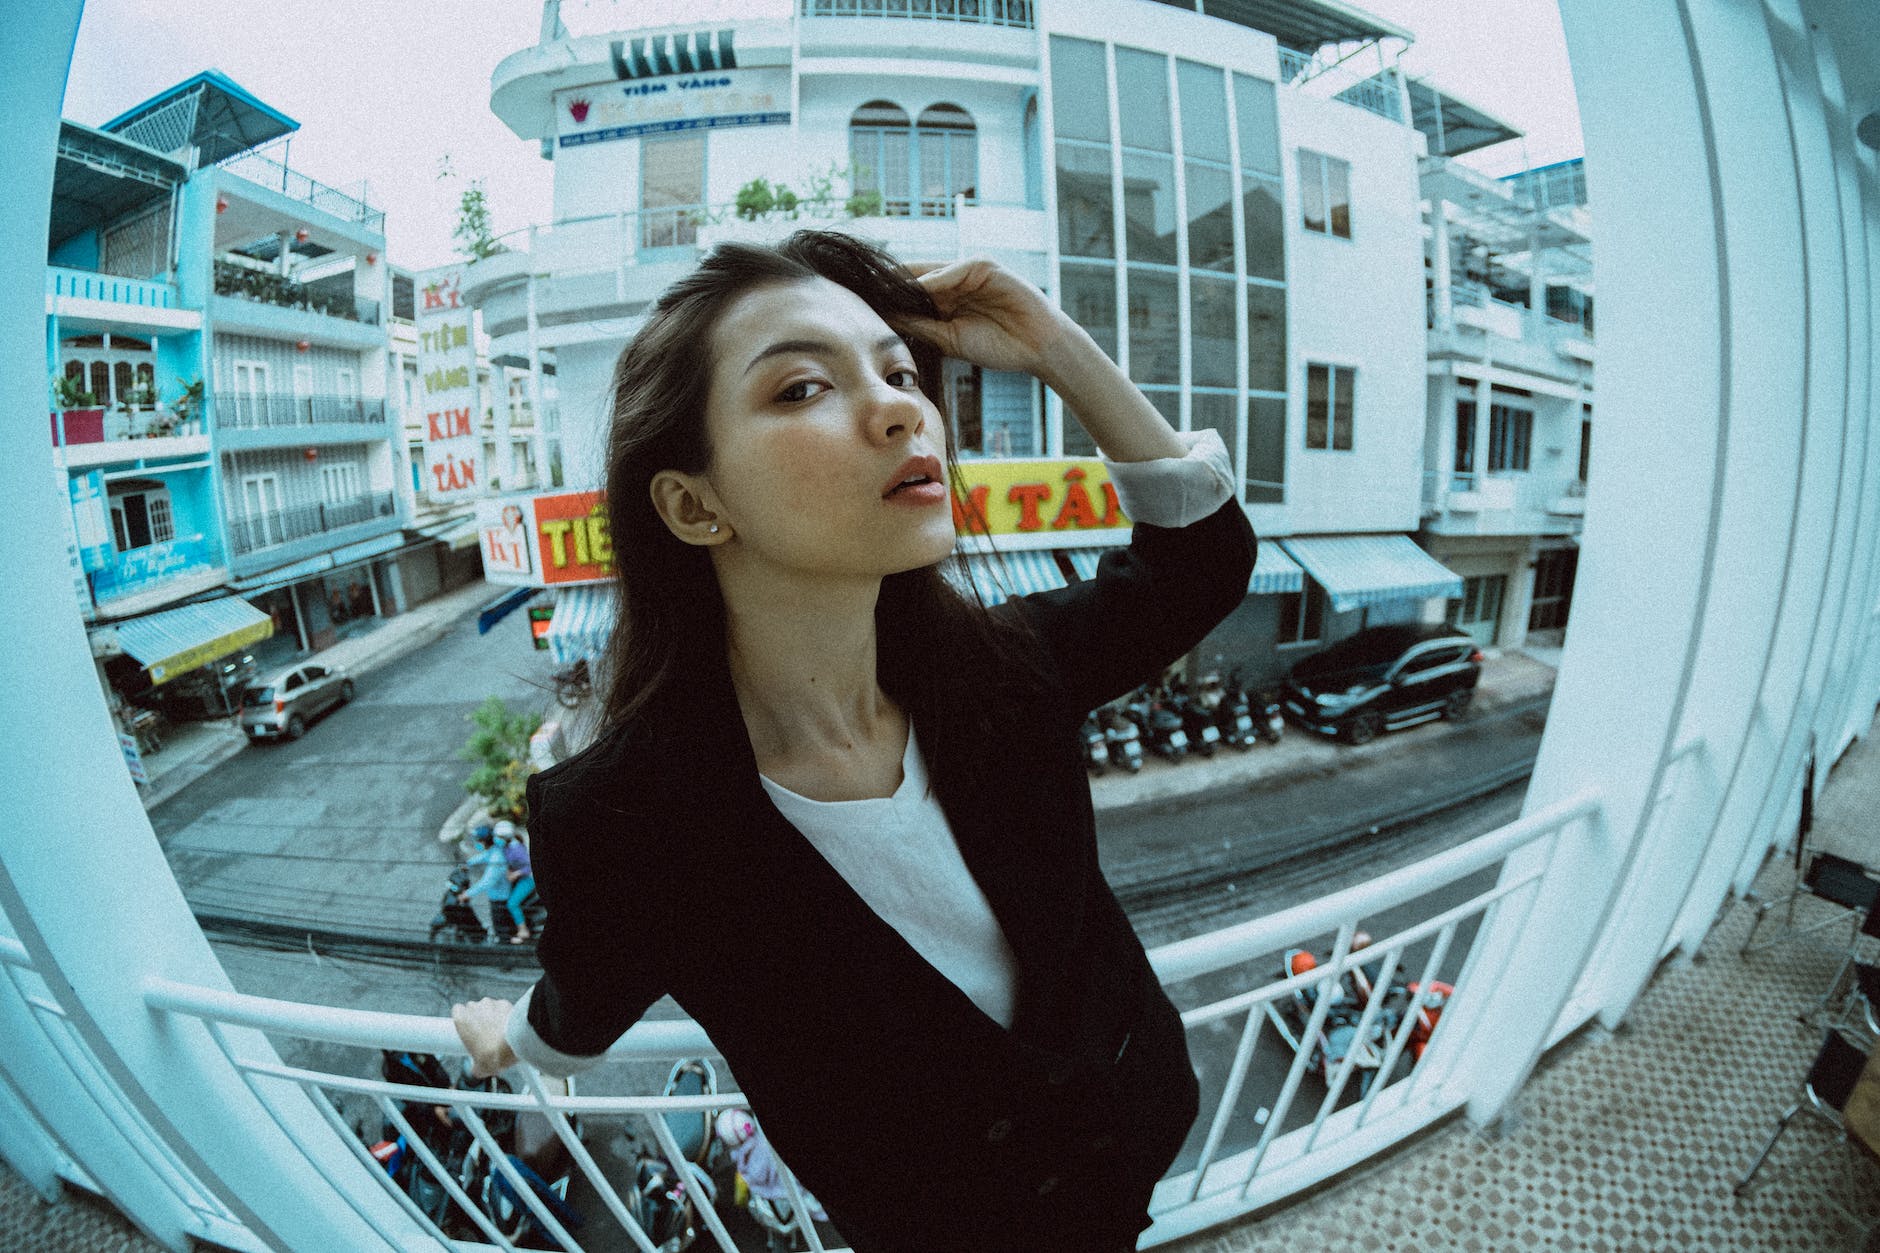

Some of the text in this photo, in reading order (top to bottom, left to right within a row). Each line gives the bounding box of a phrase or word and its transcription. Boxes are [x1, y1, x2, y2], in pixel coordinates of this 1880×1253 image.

[420, 323, 468, 354] TIỆM
[427, 406, 473, 442] KIM
[432, 453, 477, 493] TÂN
